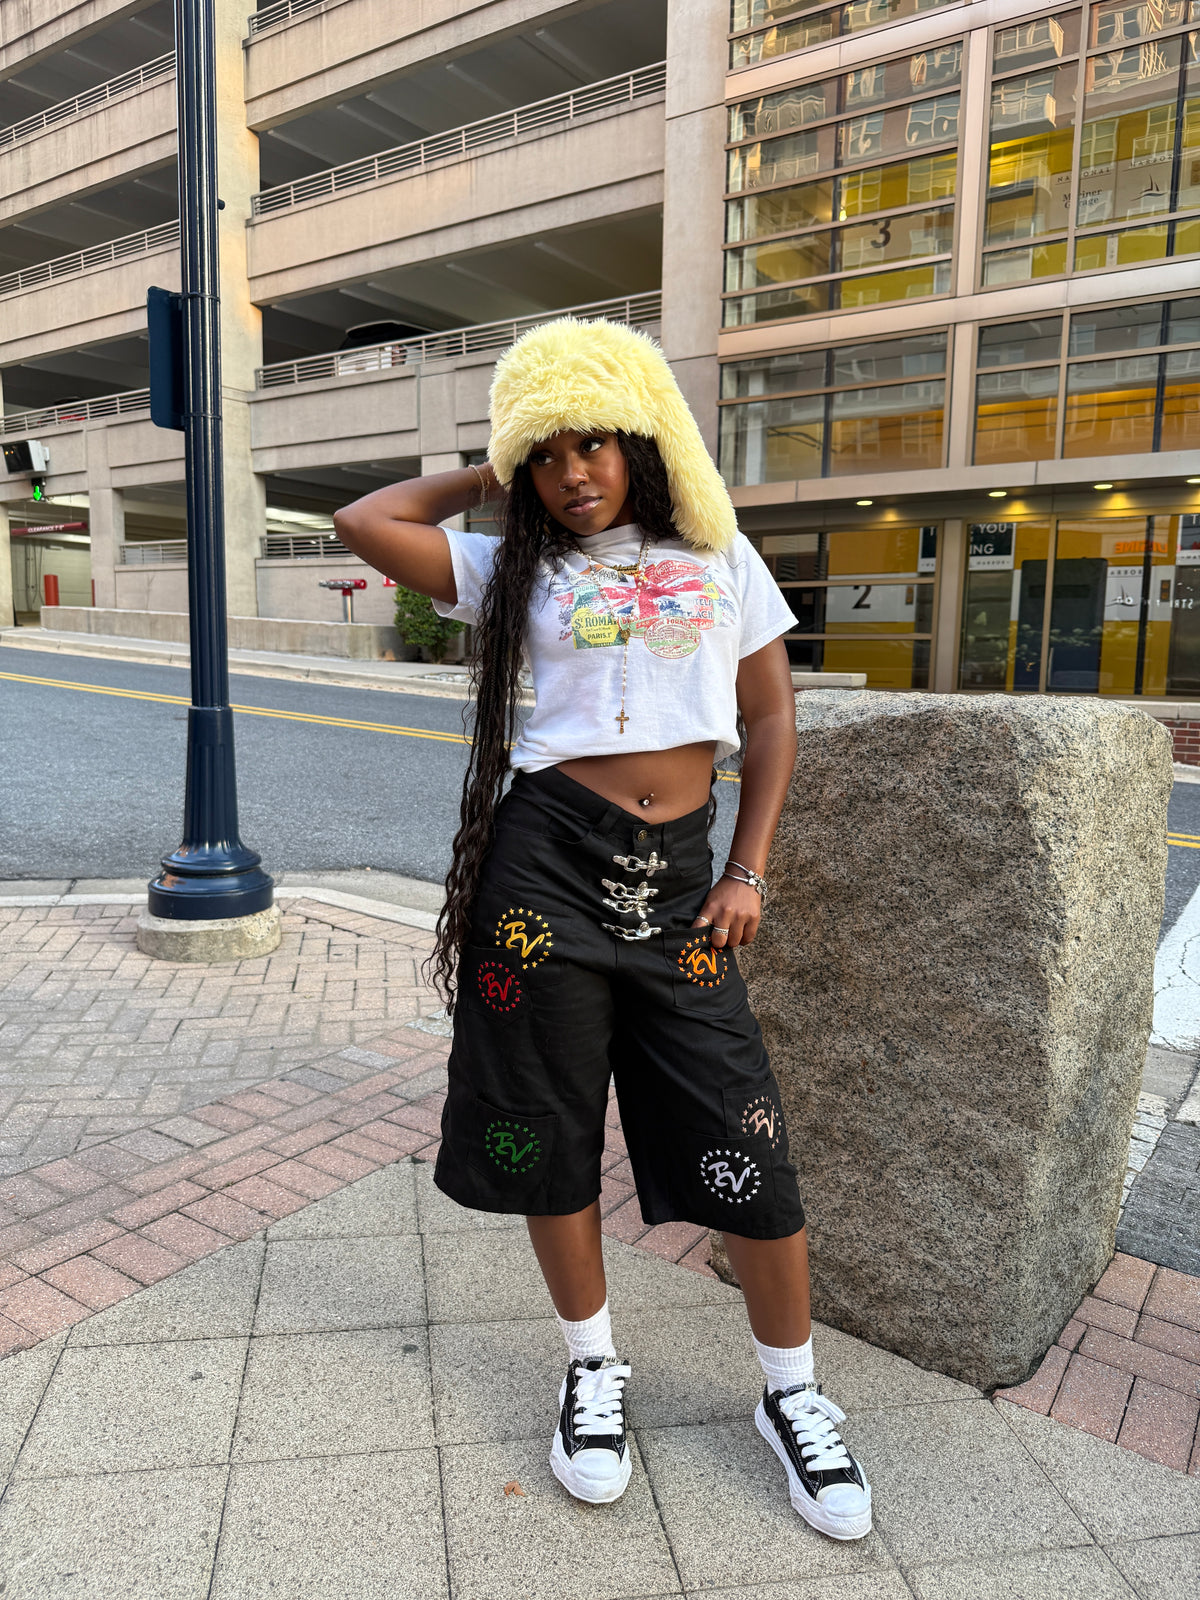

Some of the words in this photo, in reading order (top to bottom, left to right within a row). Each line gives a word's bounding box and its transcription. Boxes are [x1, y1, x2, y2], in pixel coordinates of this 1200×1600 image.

[1057, 167, 1111, 183] NAONAL
[1063, 189, 1103, 202] Miner
[870, 220, 891, 248] 3
[979, 523, 1007, 534] YOU
[852, 585, 872, 609] 2
